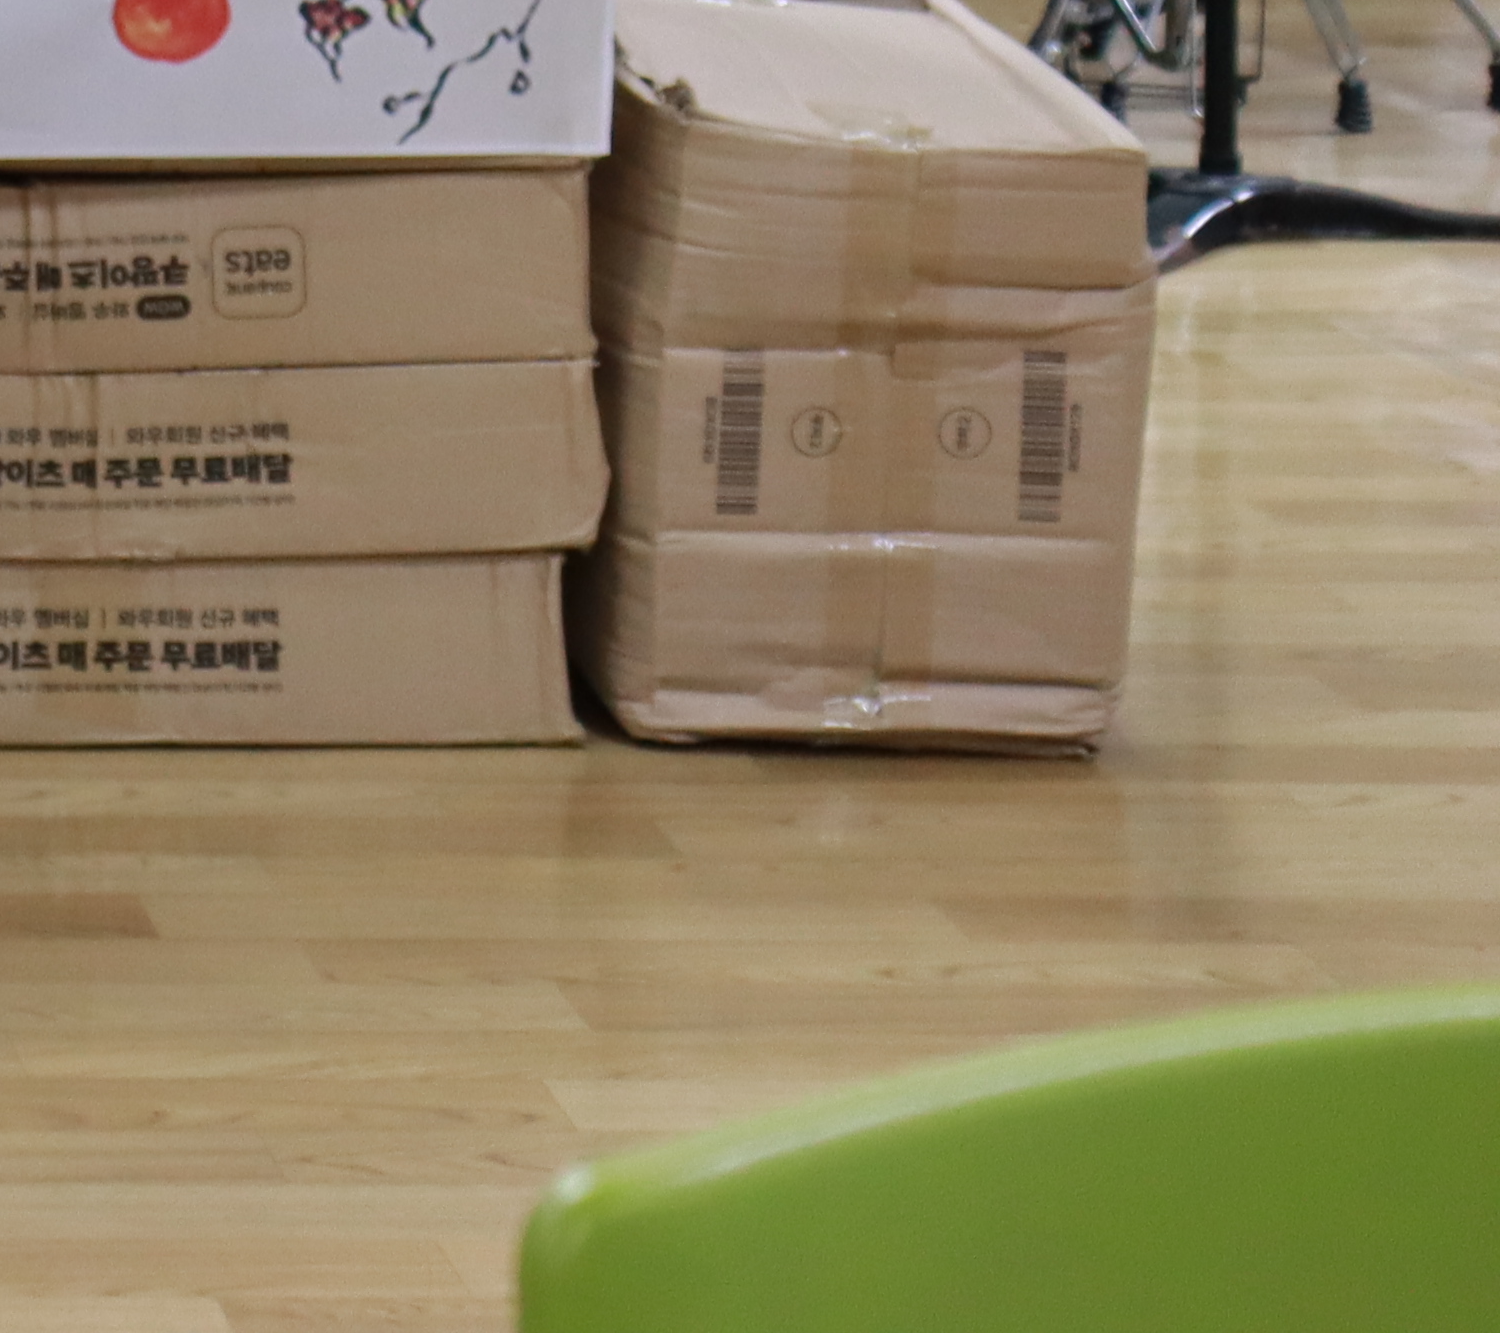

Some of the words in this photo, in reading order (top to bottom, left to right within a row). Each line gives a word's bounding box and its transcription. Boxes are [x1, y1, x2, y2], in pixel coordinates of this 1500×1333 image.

[67, 255, 189, 289] 쿠팡이츠
[224, 248, 292, 274] eats
[104, 458, 164, 489] 주문
[94, 641, 153, 672] 주문
